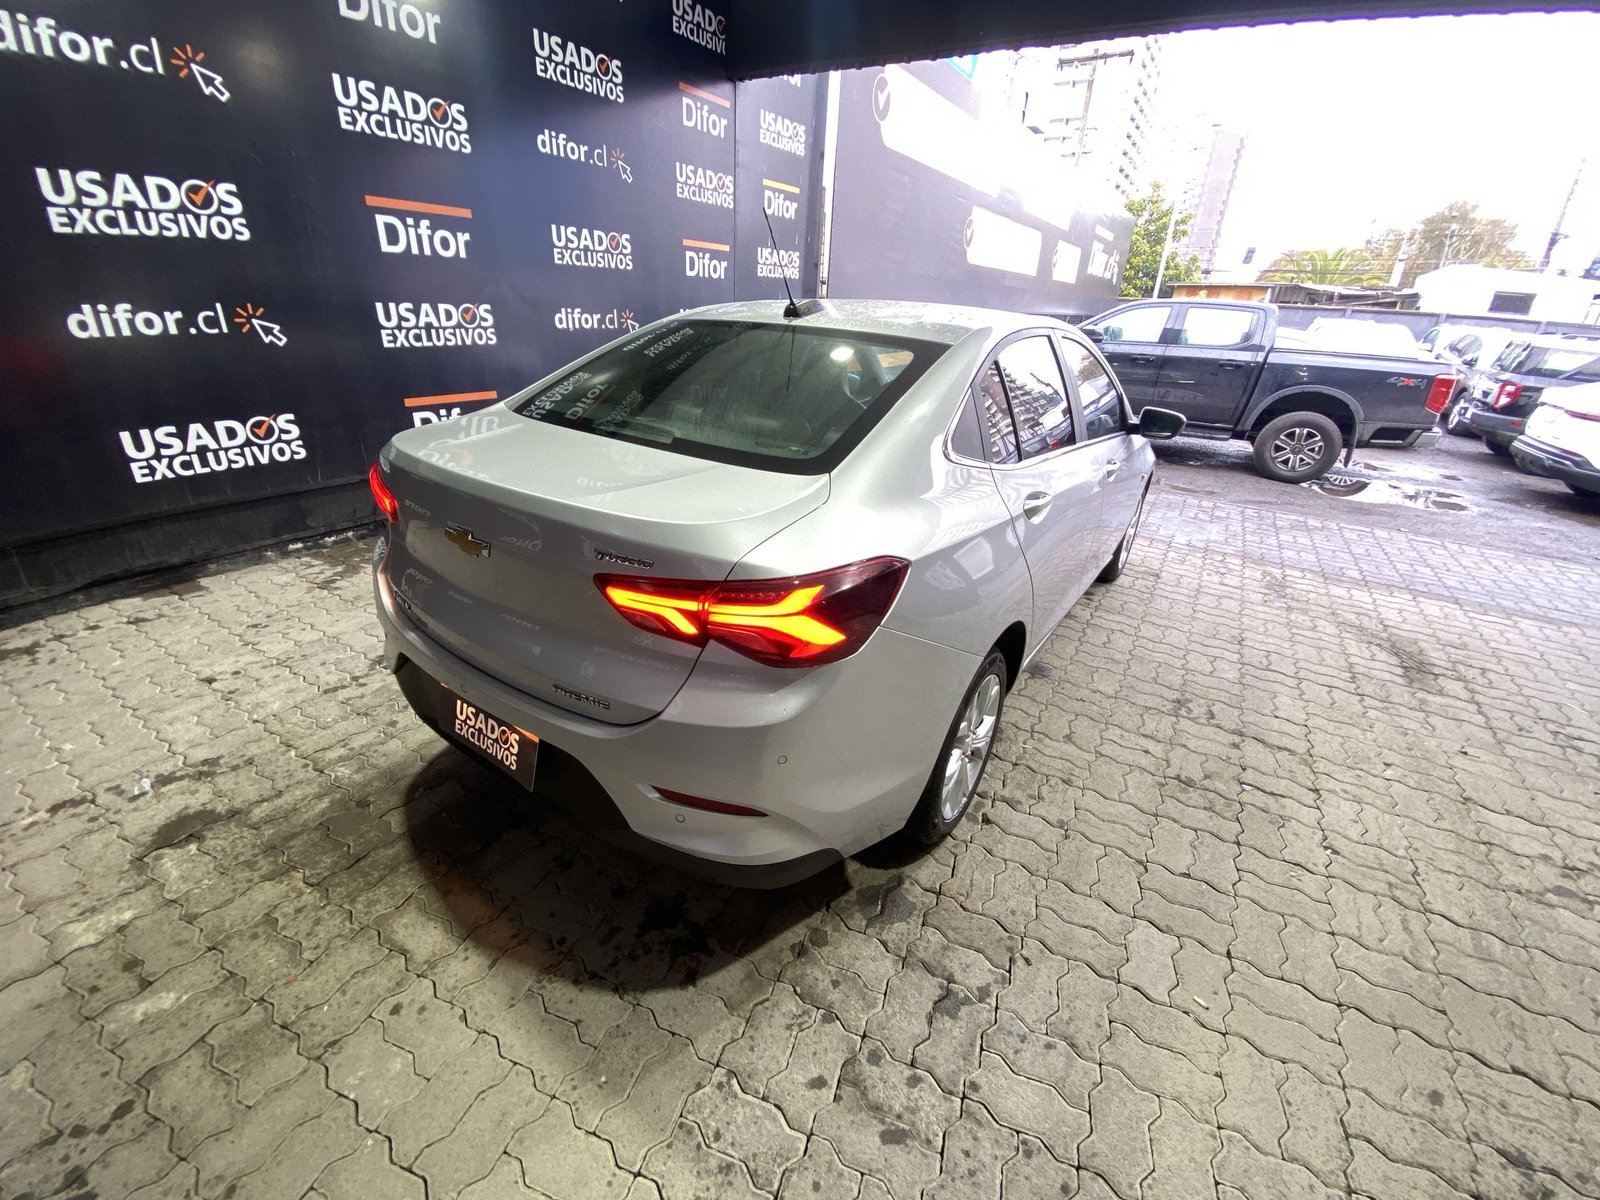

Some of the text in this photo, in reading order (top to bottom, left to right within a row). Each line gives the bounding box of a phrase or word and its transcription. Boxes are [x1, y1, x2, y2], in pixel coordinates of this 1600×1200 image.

[672, 0, 726, 39] USADO
[672, 15, 726, 56] EXCLUSIV
[532, 28, 624, 84] USADOS
[535, 56, 625, 104] EXCLUSIVOS
[332, 72, 468, 132] USADOS
[682, 96, 728, 139] Difor
[337, 106, 472, 154] EXCLUSIVOS
[760, 108, 806, 143] USADOS
[760, 128, 805, 157] EXCLUSIVOS
[536, 128, 608, 168] difor.cl
[35, 167, 243, 216] USADOS
[675, 161, 734, 195] USADOS
[676, 182, 734, 209] EXCLUSIVOS
[46, 206, 251, 241] EXCLUSIVOS
[763, 189, 798, 220] Difor
[374, 213, 471, 259] Difor
[551, 224, 632, 254] USADOS
[553, 247, 634, 271] EXCLUSIVOS
[685, 250, 728, 280] Difor
[757, 246, 800, 268] USADOS
[67, 302, 229, 339] difor.cl
[374, 302, 494, 329] USADOS
[554, 307, 618, 332] difor.cl
[380, 327, 498, 348] EXCLUSIVOS
[119, 413, 300, 460] USADOS
[129, 440, 307, 484] EXCLUSIVOS
[455, 718, 518, 771] EXCLUSIVOS
[456, 699, 520, 755] USADOS
